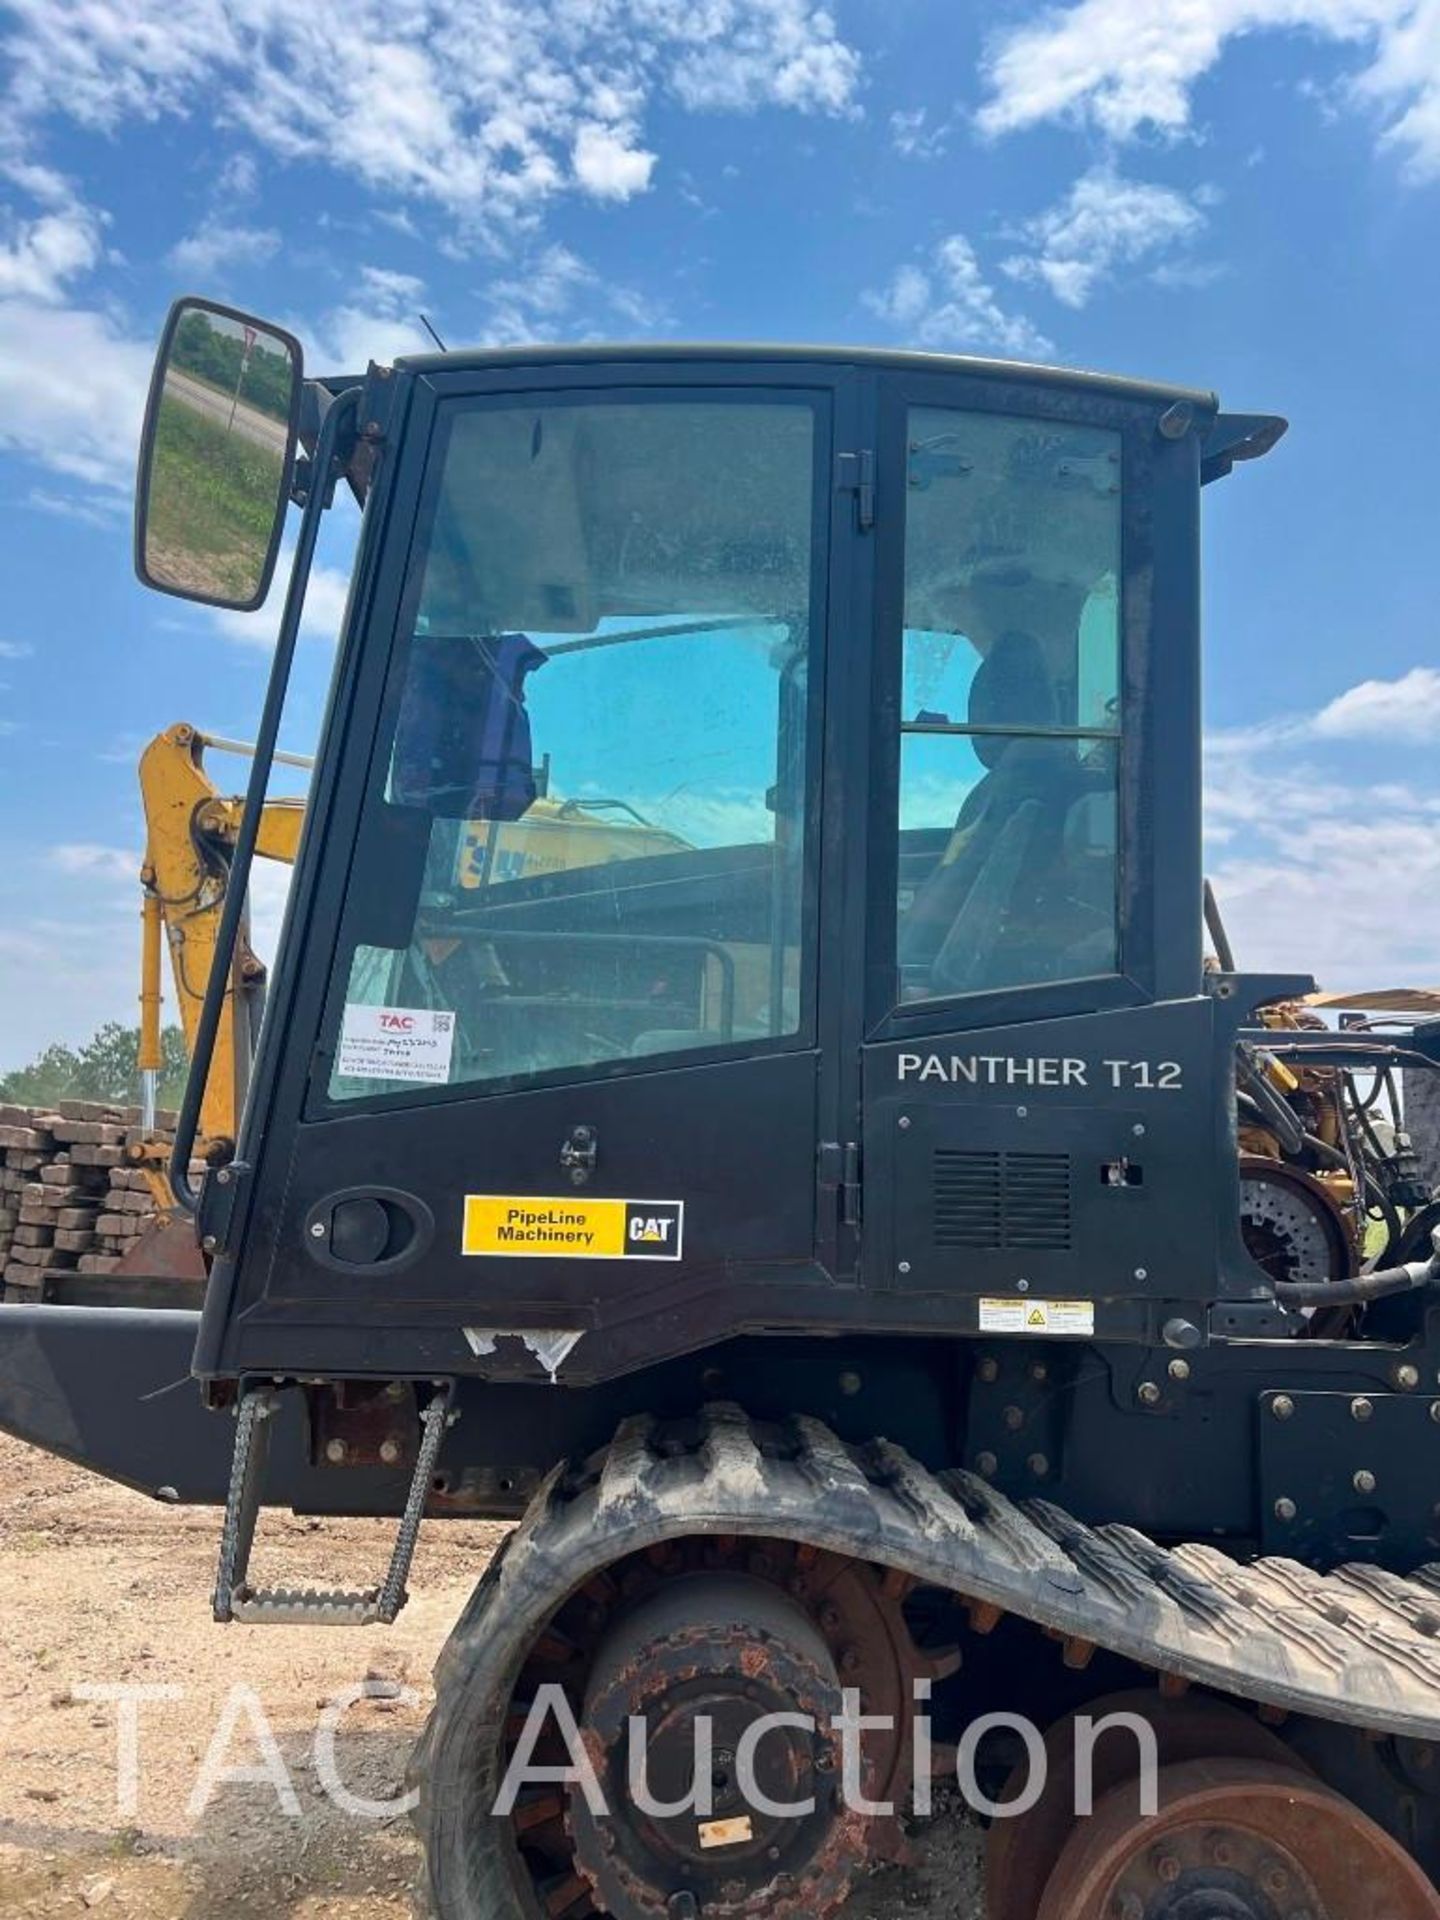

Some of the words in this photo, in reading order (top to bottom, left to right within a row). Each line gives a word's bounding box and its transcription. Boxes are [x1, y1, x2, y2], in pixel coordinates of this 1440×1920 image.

[380, 1014, 414, 1029] TAC
[898, 1054, 1088, 1086] PANTHER
[1102, 1060, 1183, 1089] T12
[508, 1209, 586, 1226] PipeLine
[497, 1226, 594, 1246] Machinery
[629, 1216, 672, 1242] CAT
